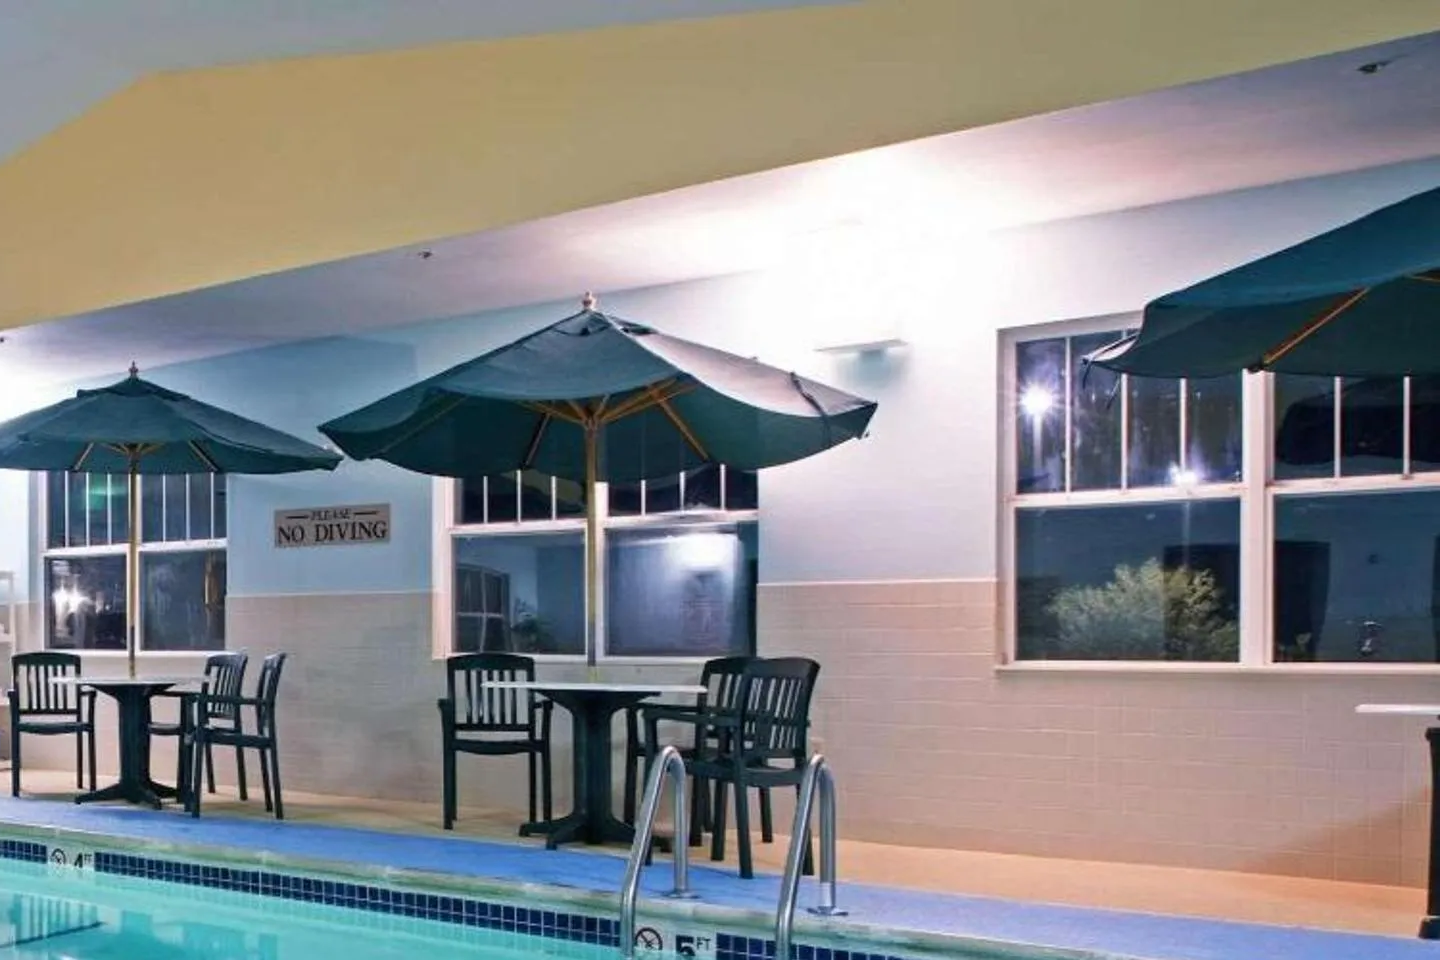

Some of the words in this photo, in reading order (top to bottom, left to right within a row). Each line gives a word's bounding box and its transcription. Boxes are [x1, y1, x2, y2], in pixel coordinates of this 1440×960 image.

[278, 524, 305, 543] NO
[314, 520, 387, 542] DIVING
[696, 936, 711, 951] FT
